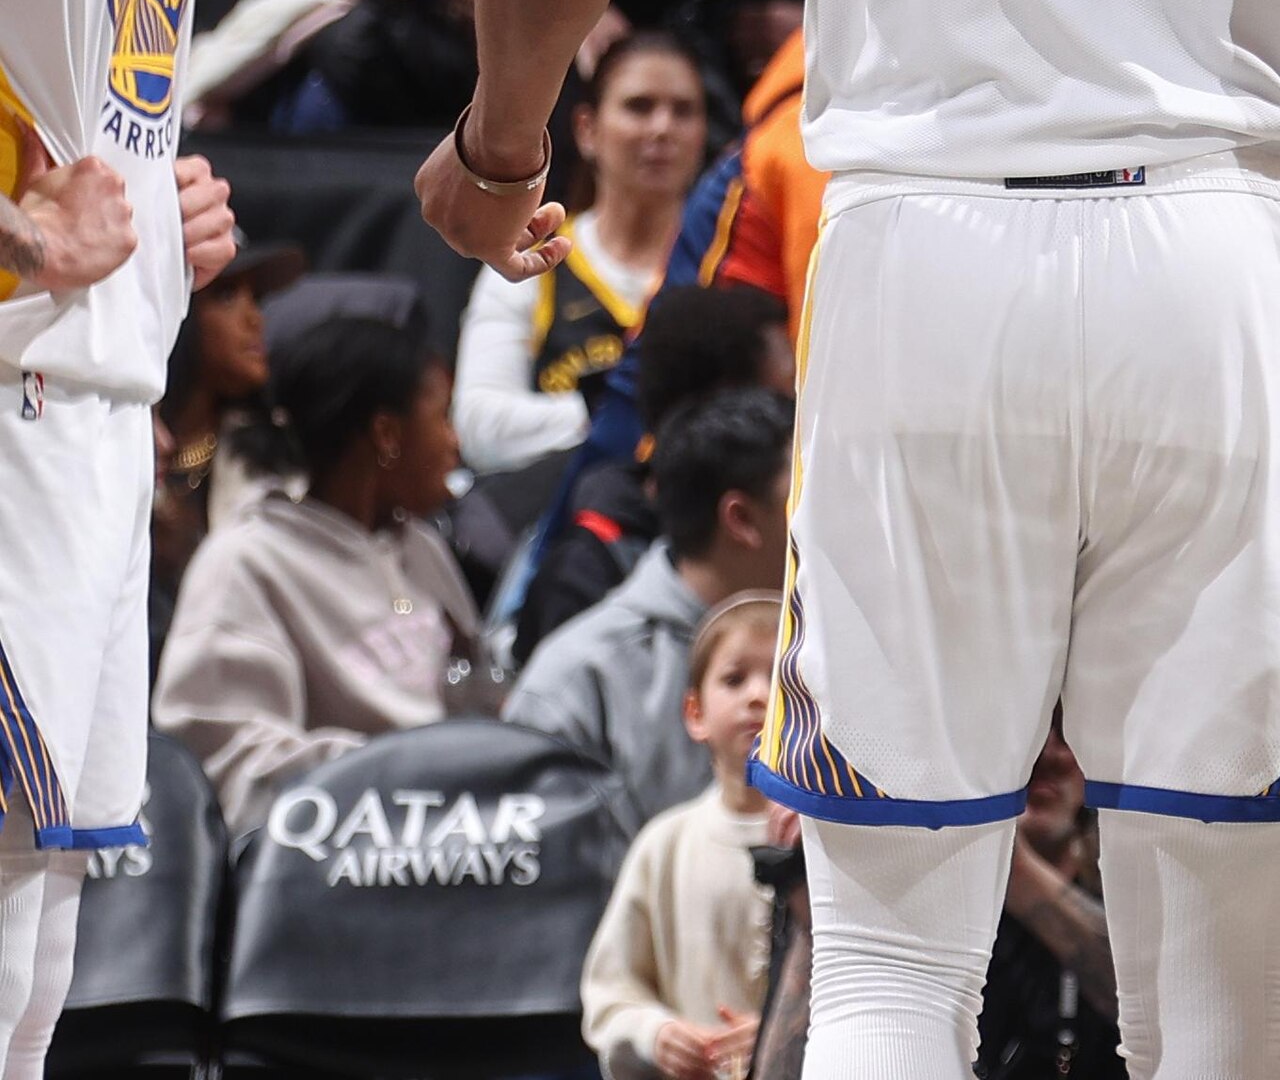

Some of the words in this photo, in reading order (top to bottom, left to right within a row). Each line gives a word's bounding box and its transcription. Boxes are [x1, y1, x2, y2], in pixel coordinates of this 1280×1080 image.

[101, 102, 172, 158] ARRIO
[267, 786, 546, 862] QATAR
[326, 843, 541, 887] AIRWAYS
